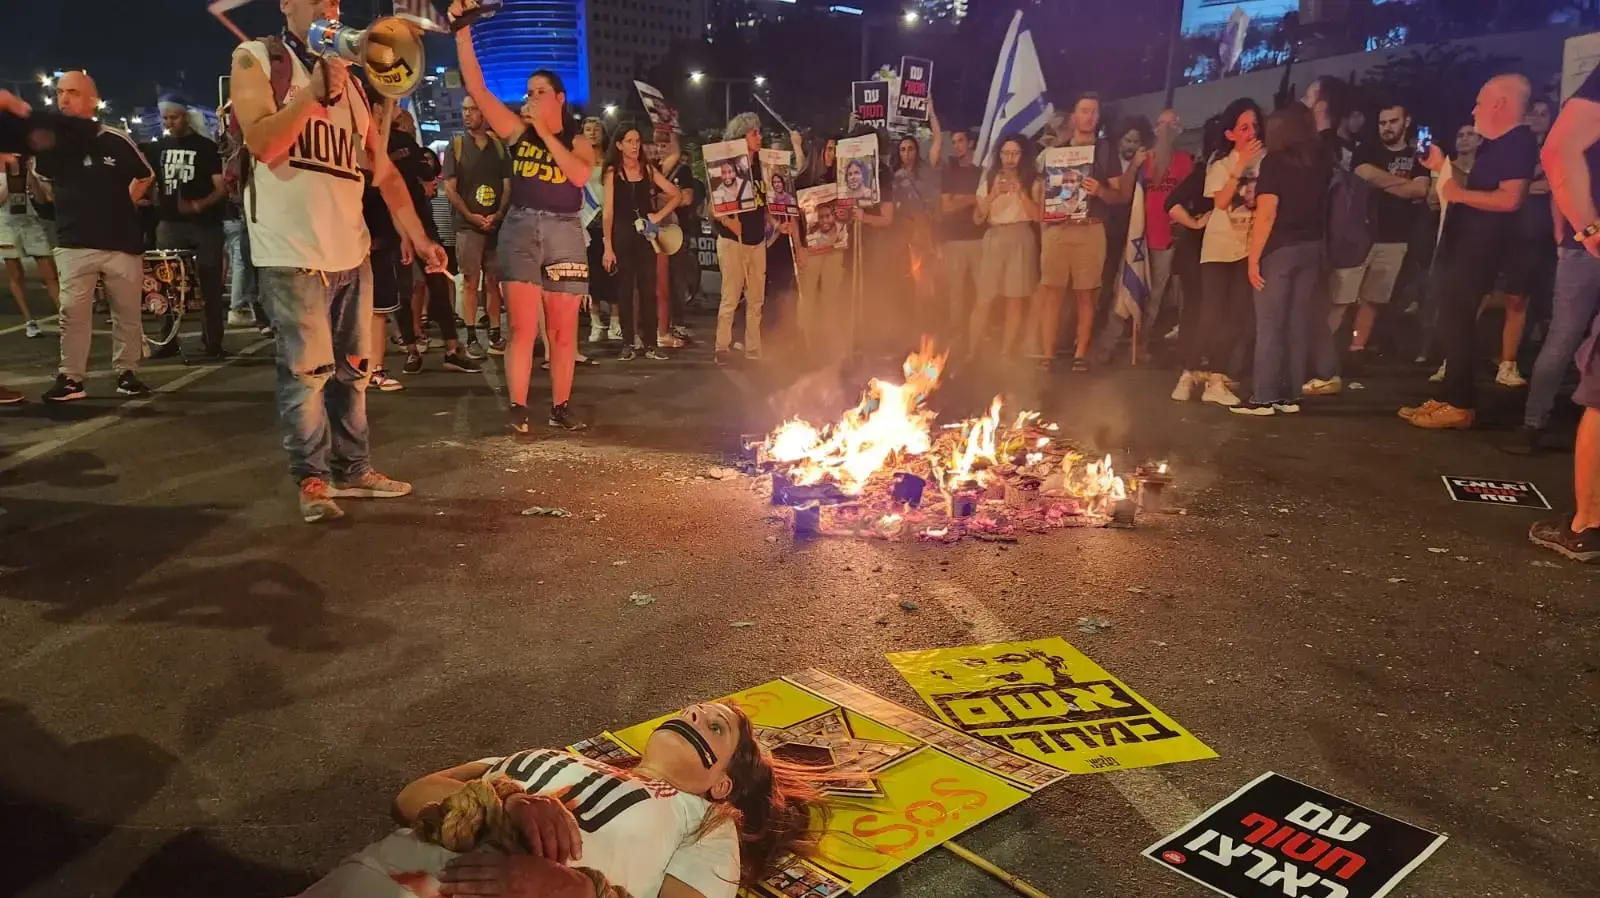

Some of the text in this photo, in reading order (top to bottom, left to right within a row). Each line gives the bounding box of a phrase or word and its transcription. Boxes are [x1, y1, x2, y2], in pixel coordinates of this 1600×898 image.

[910, 66, 923, 80] עם
[863, 89, 880, 103] עם
[944, 683, 1133, 726] אשם
[1284, 800, 1371, 842] עם
[1240, 812, 1367, 880] חטוף
